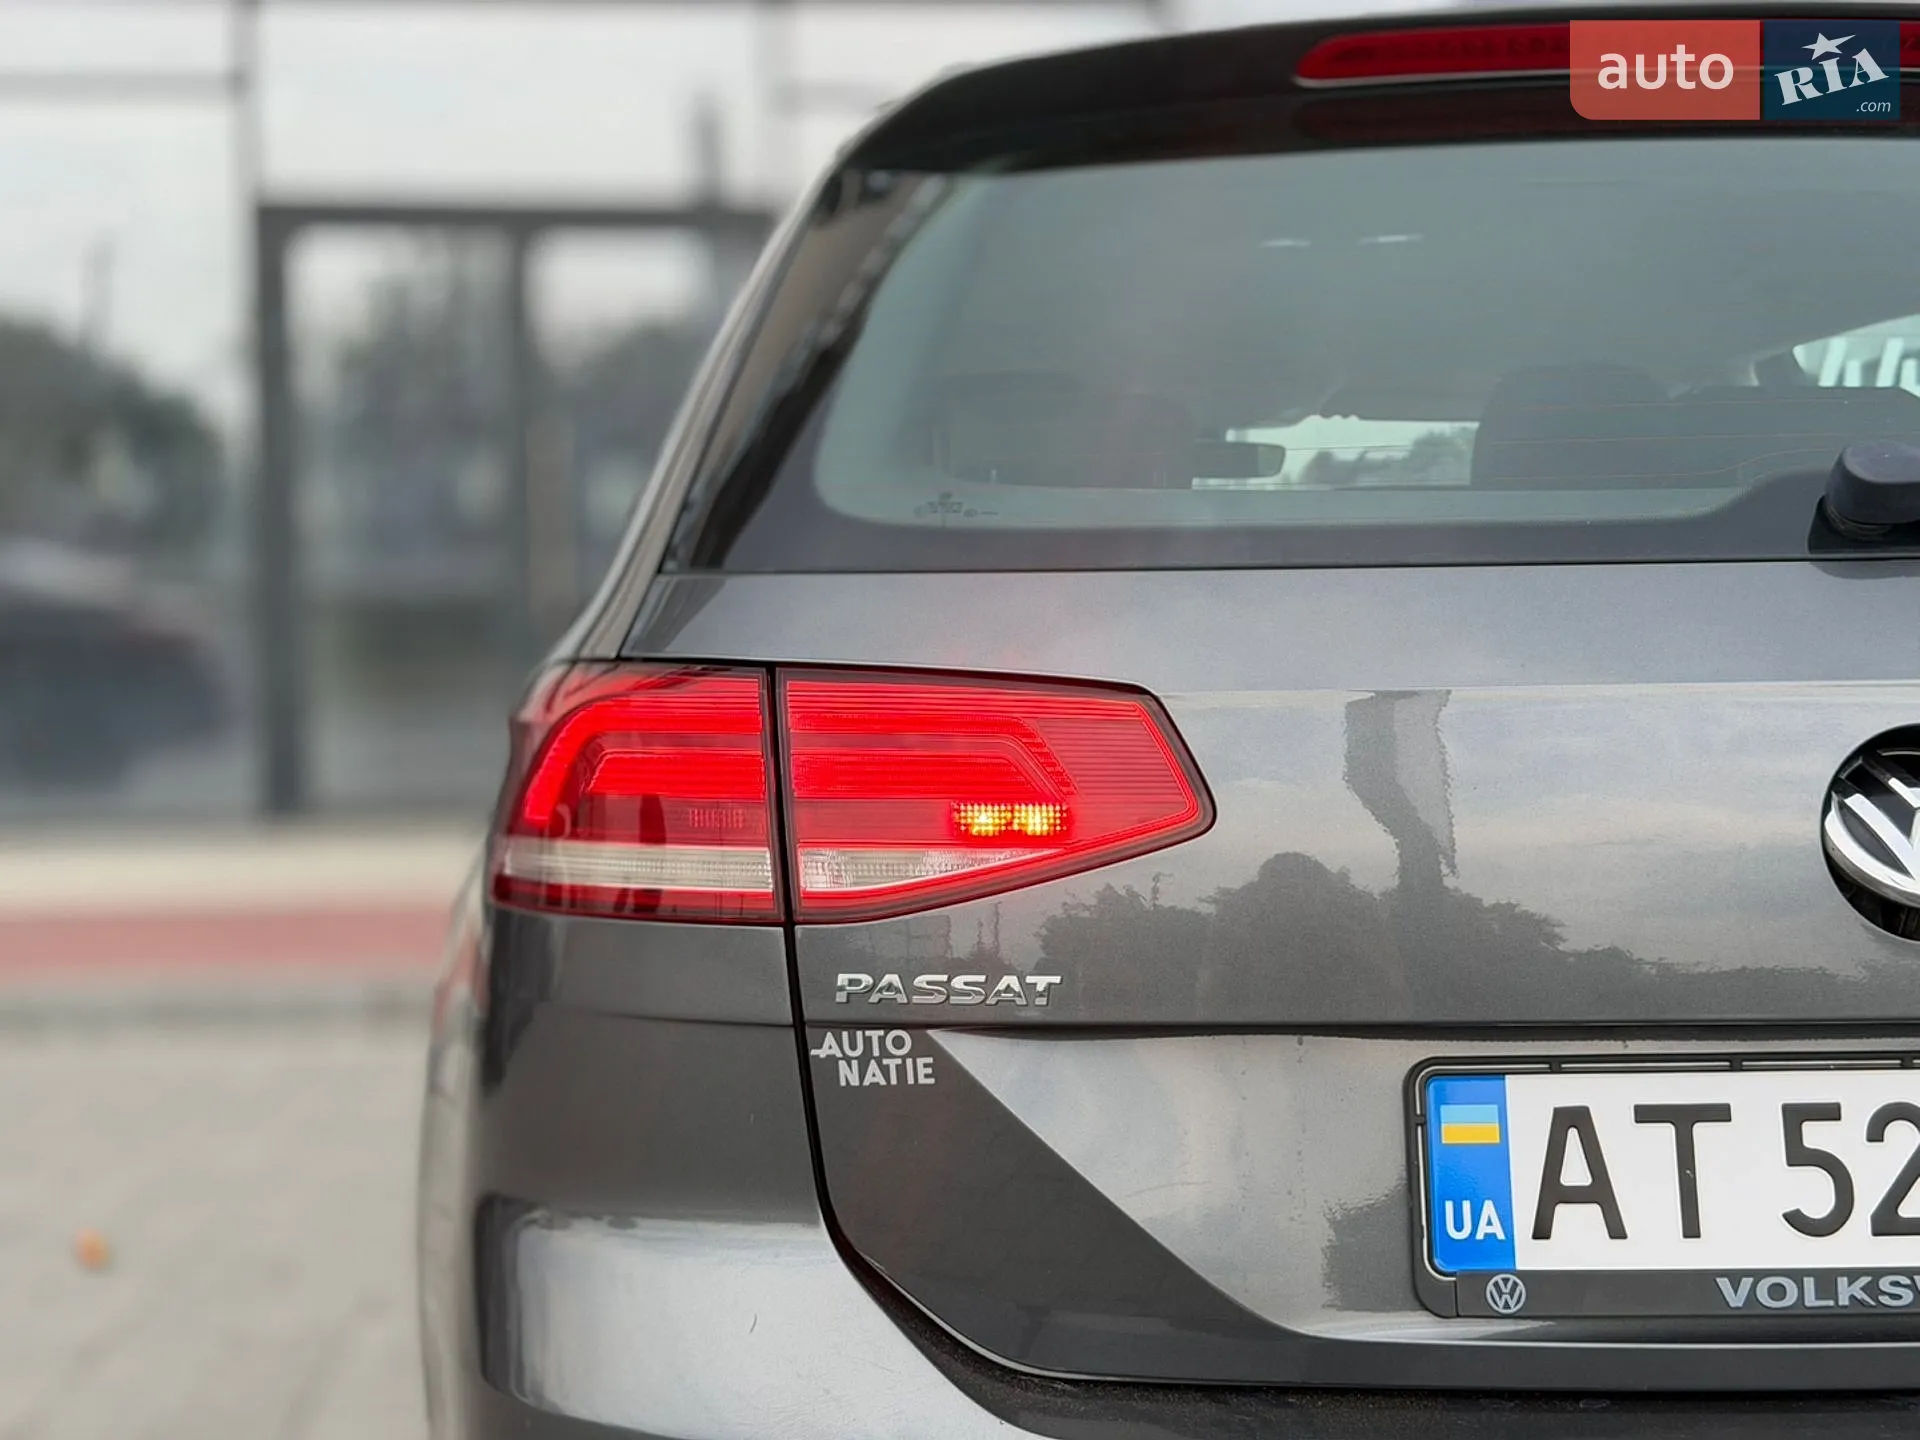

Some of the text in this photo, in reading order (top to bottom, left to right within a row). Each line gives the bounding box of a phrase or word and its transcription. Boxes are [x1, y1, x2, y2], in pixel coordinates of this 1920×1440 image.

[835, 973, 1062, 1006] PASSAT
[811, 1029, 912, 1058] AUTO
[838, 1057, 936, 1087] NATIE
[1532, 1102, 1732, 1240] AT
[1444, 1199, 1506, 1240] UA
[1715, 1275, 1920, 1308] VOLKS
